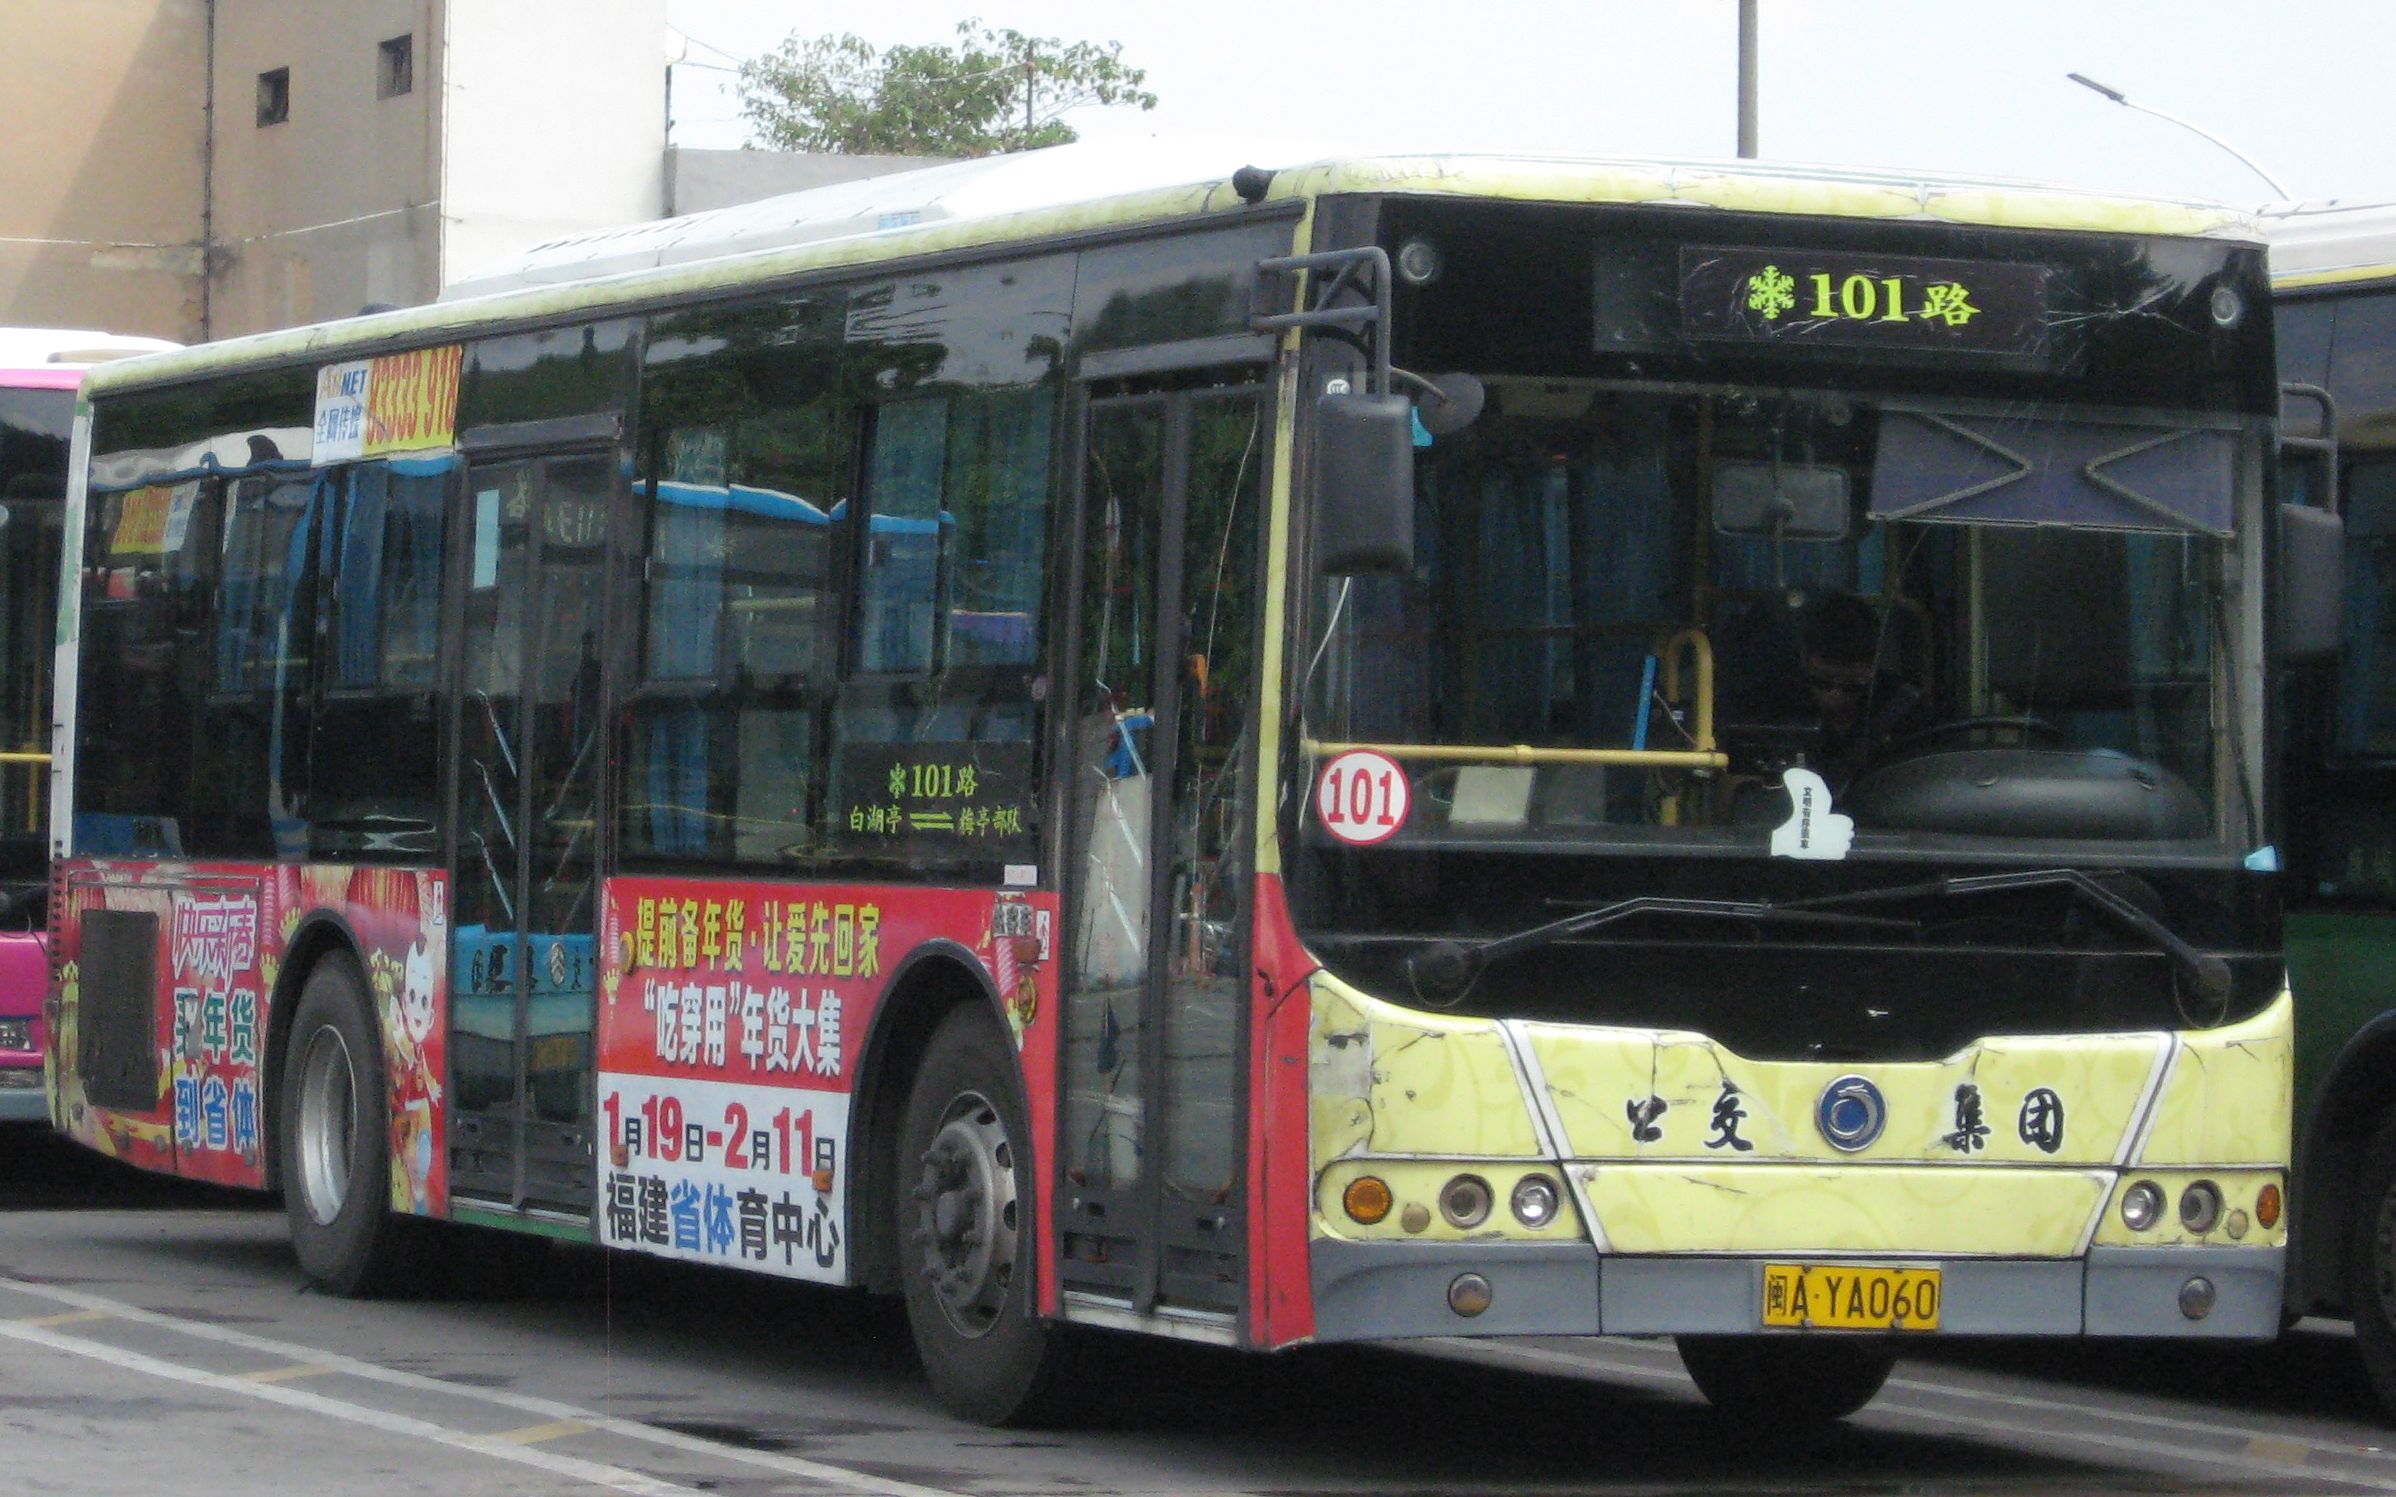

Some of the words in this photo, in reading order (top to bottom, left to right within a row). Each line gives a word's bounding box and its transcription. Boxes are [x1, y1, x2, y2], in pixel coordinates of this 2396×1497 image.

[850, 804, 902, 834] 白湖亭
[1328, 768, 1394, 825] 101
[175, 1075, 256, 1153] 到省体
[1942, 1083, 2065, 1154] 集团
[606, 1170, 840, 1268] 福建省体育中心
